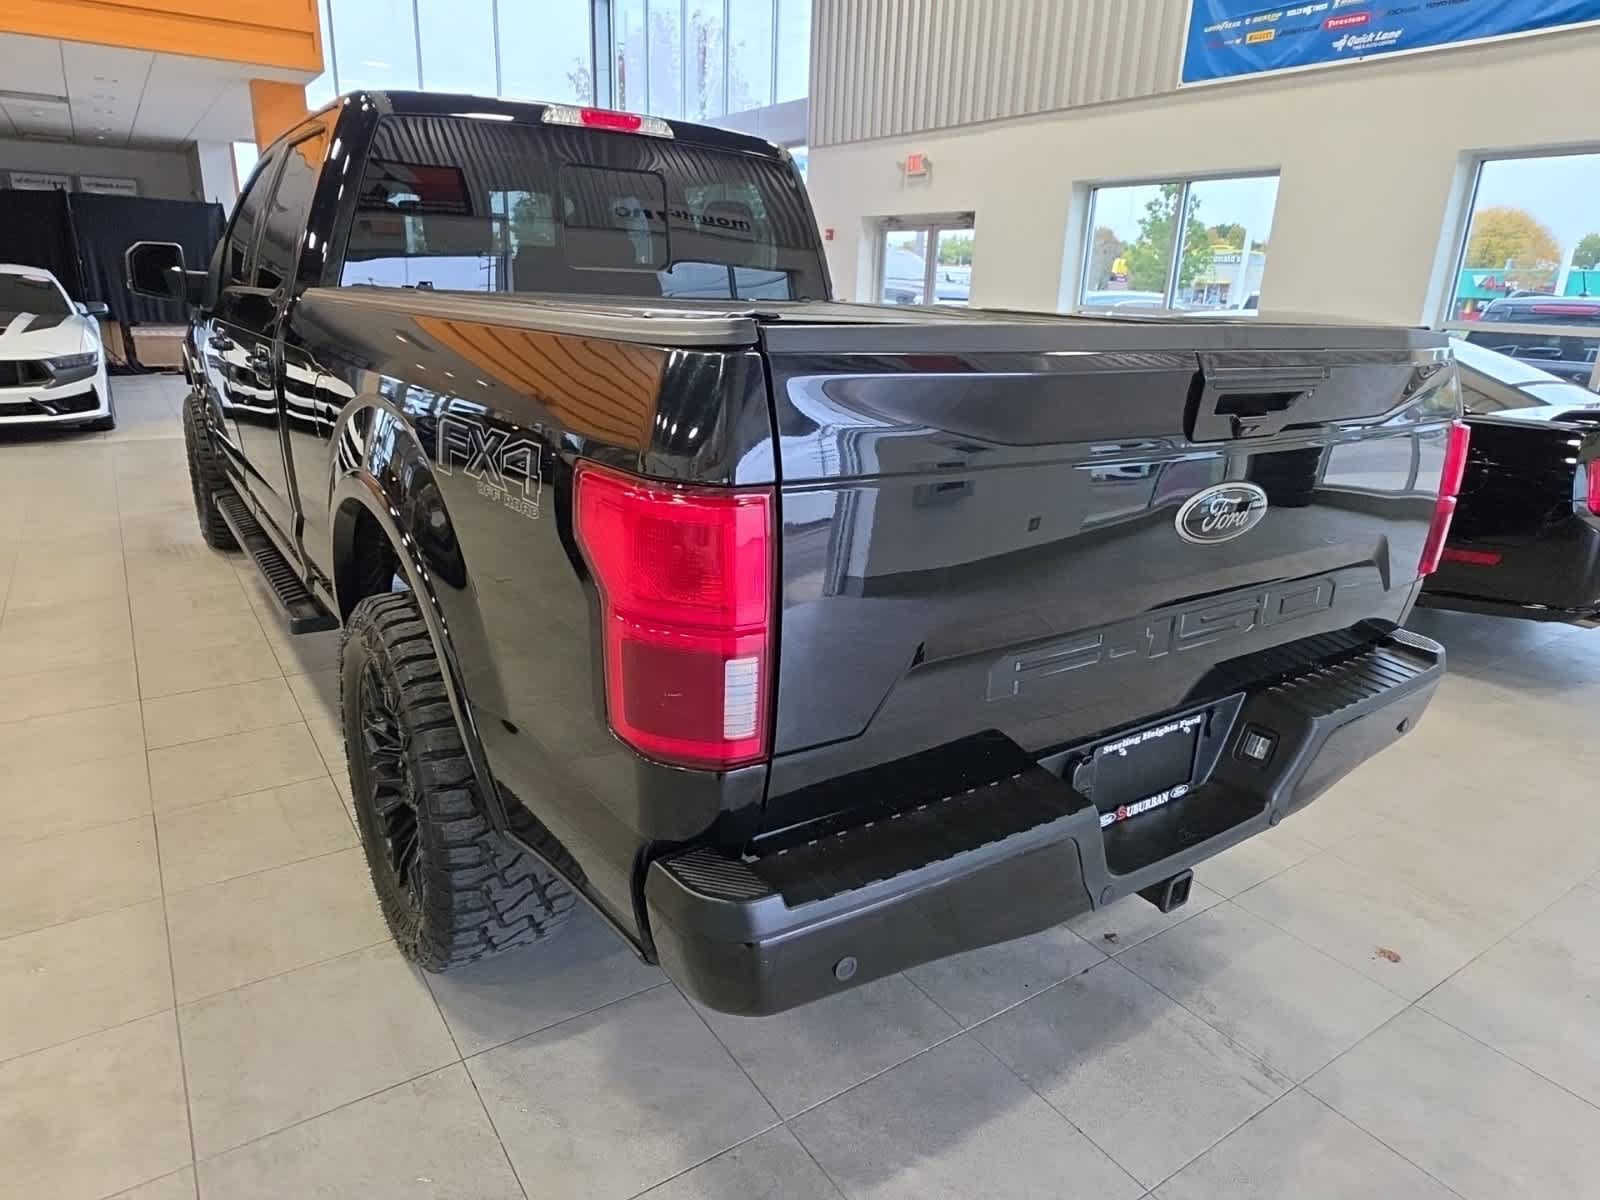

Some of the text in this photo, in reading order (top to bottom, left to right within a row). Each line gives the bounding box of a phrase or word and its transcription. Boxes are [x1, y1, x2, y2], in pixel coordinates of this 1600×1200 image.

[1327, 15, 1367, 28] Firestone
[1347, 32, 1375, 46] Quick
[1375, 28, 1404, 41] Lane
[436, 411, 542, 507] FX4
[1201, 496, 1249, 532] Ford
[986, 577, 1336, 703] F-150
[1102, 714, 1201, 755] Sterling Heights Ford
